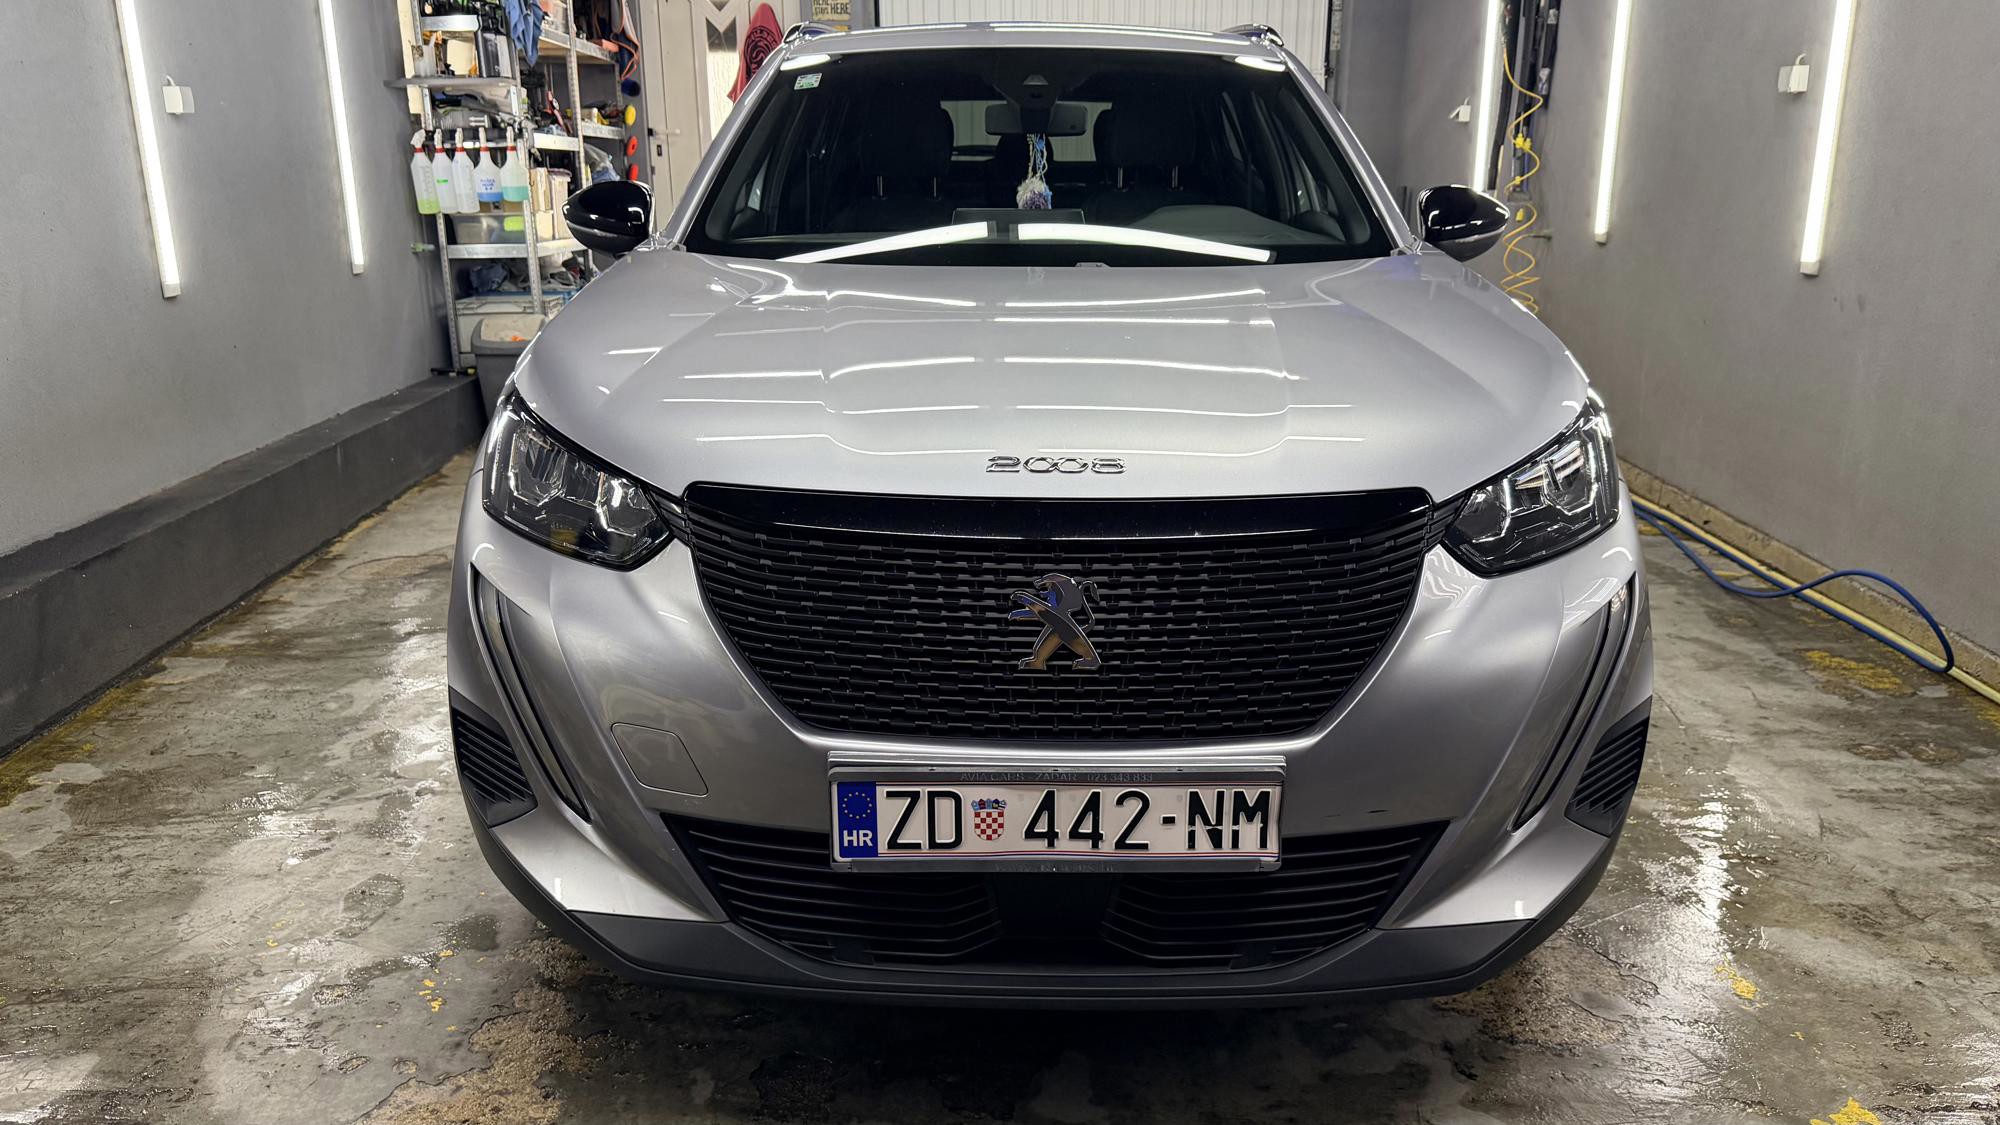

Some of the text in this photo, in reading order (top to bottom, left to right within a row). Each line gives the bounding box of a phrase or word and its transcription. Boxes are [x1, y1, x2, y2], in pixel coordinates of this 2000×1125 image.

[830, 2, 850, 15] HERE
[986, 455, 1127, 474] 2008
[884, 789, 963, 850] ZD
[843, 829, 873, 847] HR
